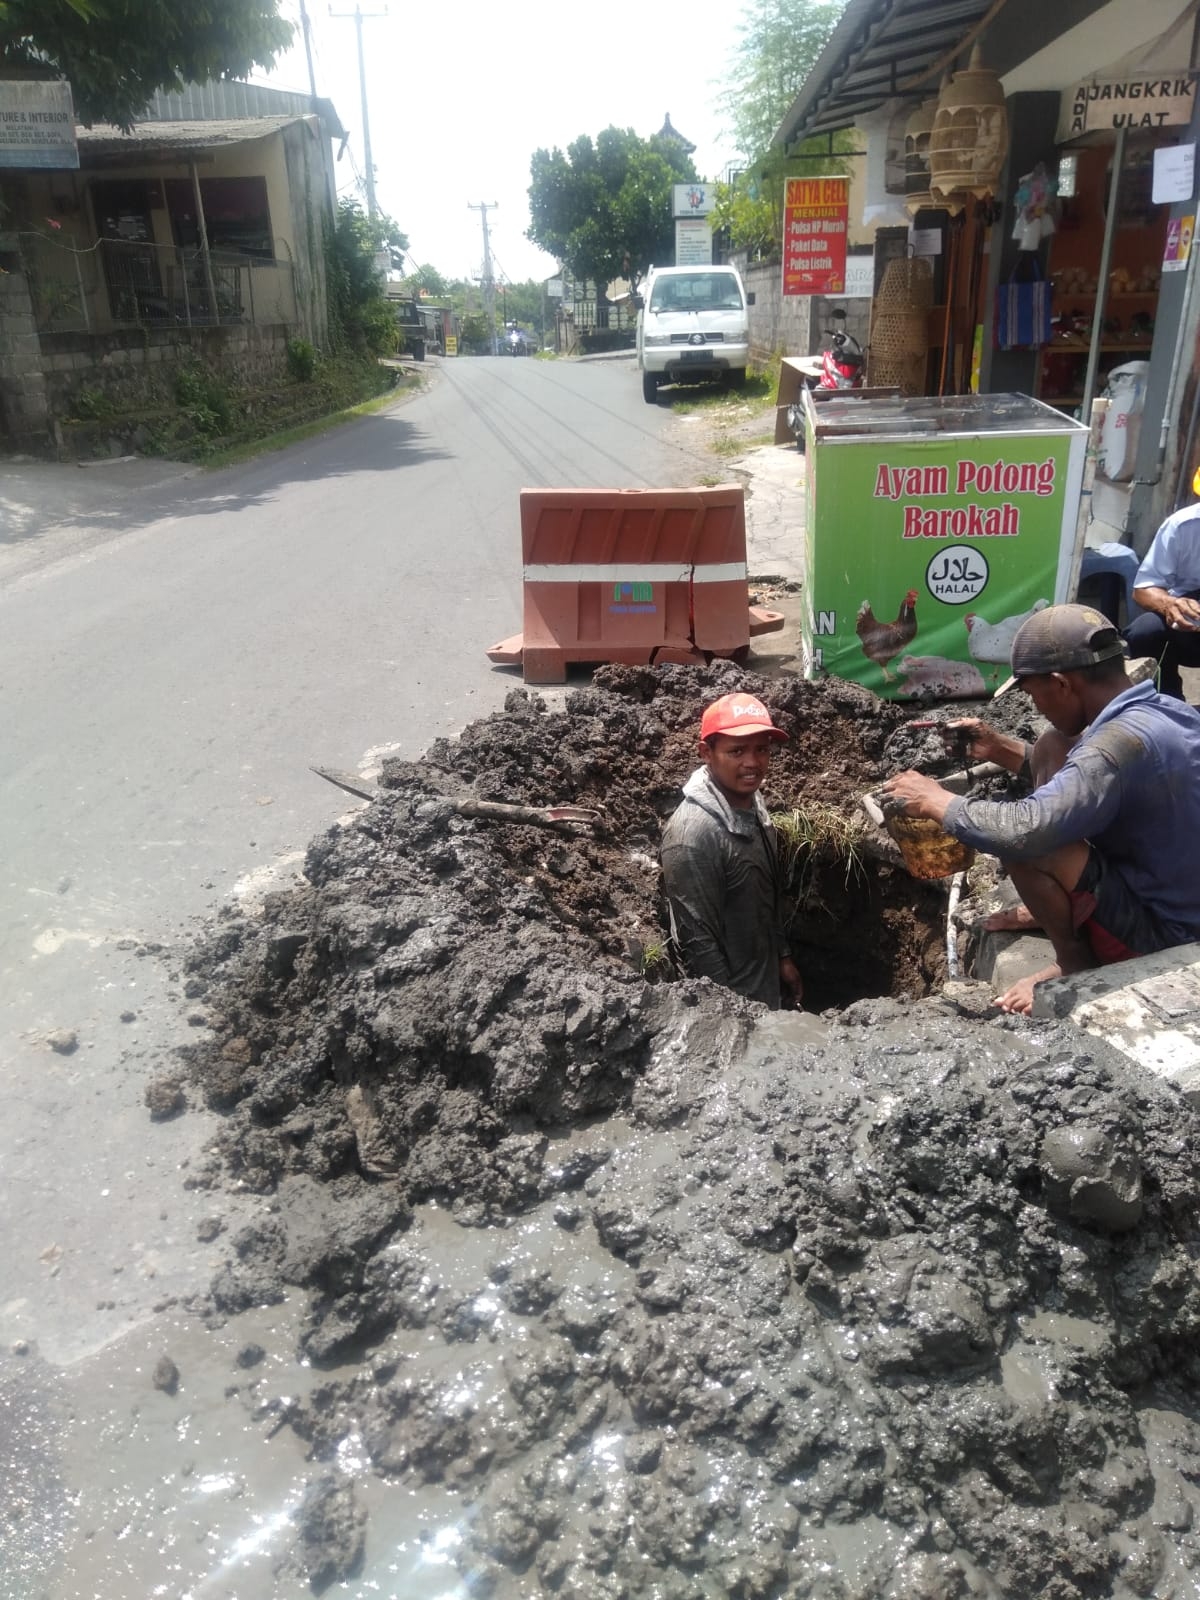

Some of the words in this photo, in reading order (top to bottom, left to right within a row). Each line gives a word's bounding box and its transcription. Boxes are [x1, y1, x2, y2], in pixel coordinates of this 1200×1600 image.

[1088, 80, 1196, 100] JANGKRIK
[29, 112, 69, 123] INTERIOR
[1112, 112, 1170, 128] ULAT
[788, 180, 820, 206] SATYA
[823, 179, 848, 205] CELL
[793, 208, 839, 218] MENJUAL
[791, 221, 811, 234] Pulsa
[811, 221, 822, 233] HP
[822, 220, 845, 233] Murah
[790, 240, 811, 252] Paket
[811, 239, 828, 252] Data
[790, 258, 810, 270] Pulsa
[810, 257, 833, 270] Listrik
[874, 462, 949, 501] Ayam
[955, 458, 1056, 496] Potong
[902, 503, 1020, 539] Barokah
[931, 556, 985, 582] حلال
[935, 584, 978, 594] HALAL
